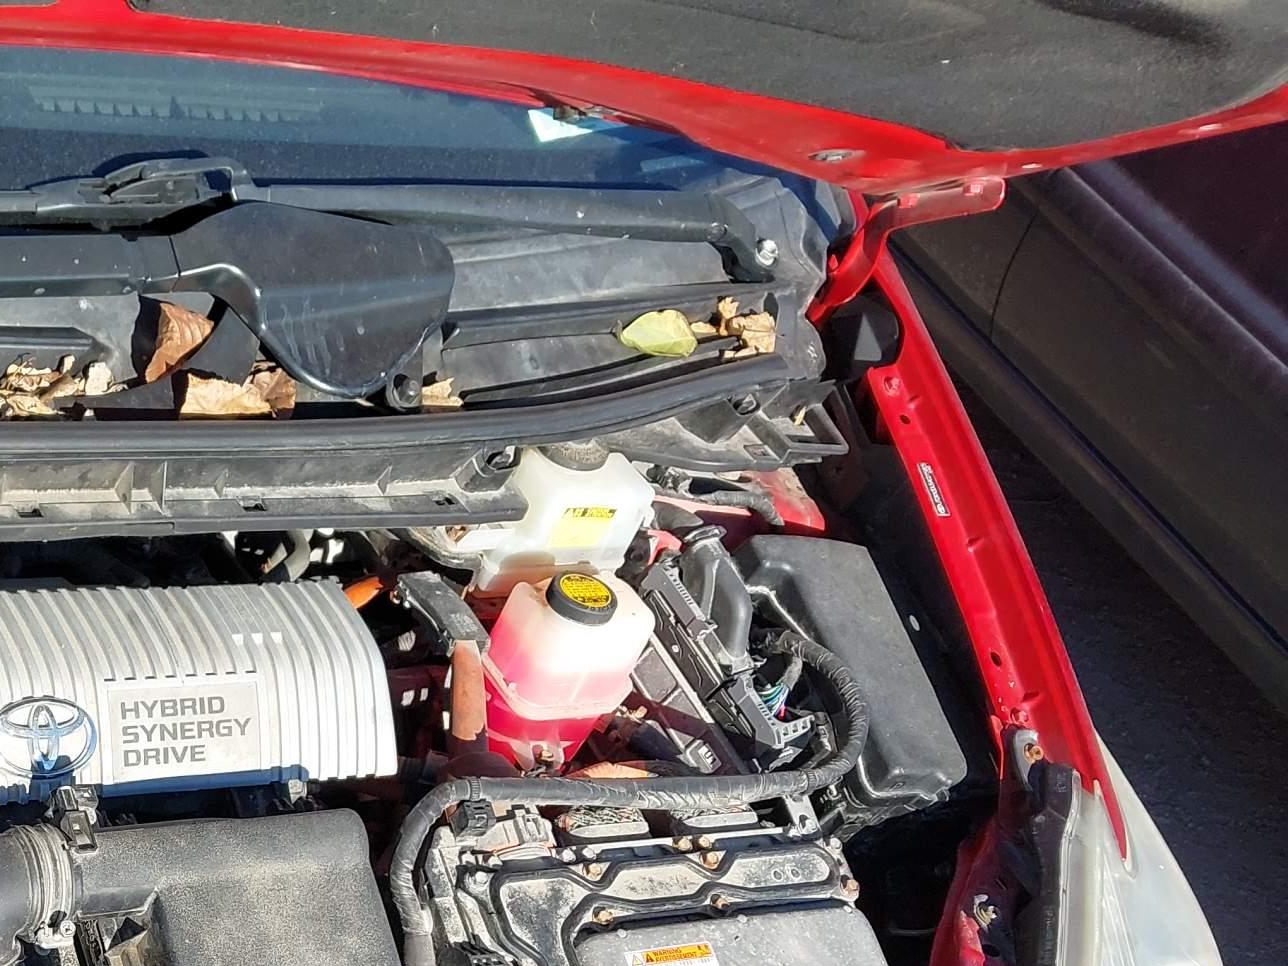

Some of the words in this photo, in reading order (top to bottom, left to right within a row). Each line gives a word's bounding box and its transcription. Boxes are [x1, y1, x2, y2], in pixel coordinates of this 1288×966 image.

[120, 696, 225, 719] HYBRID
[122, 719, 251, 743] SYNERGY
[124, 745, 206, 766] DRIVE
